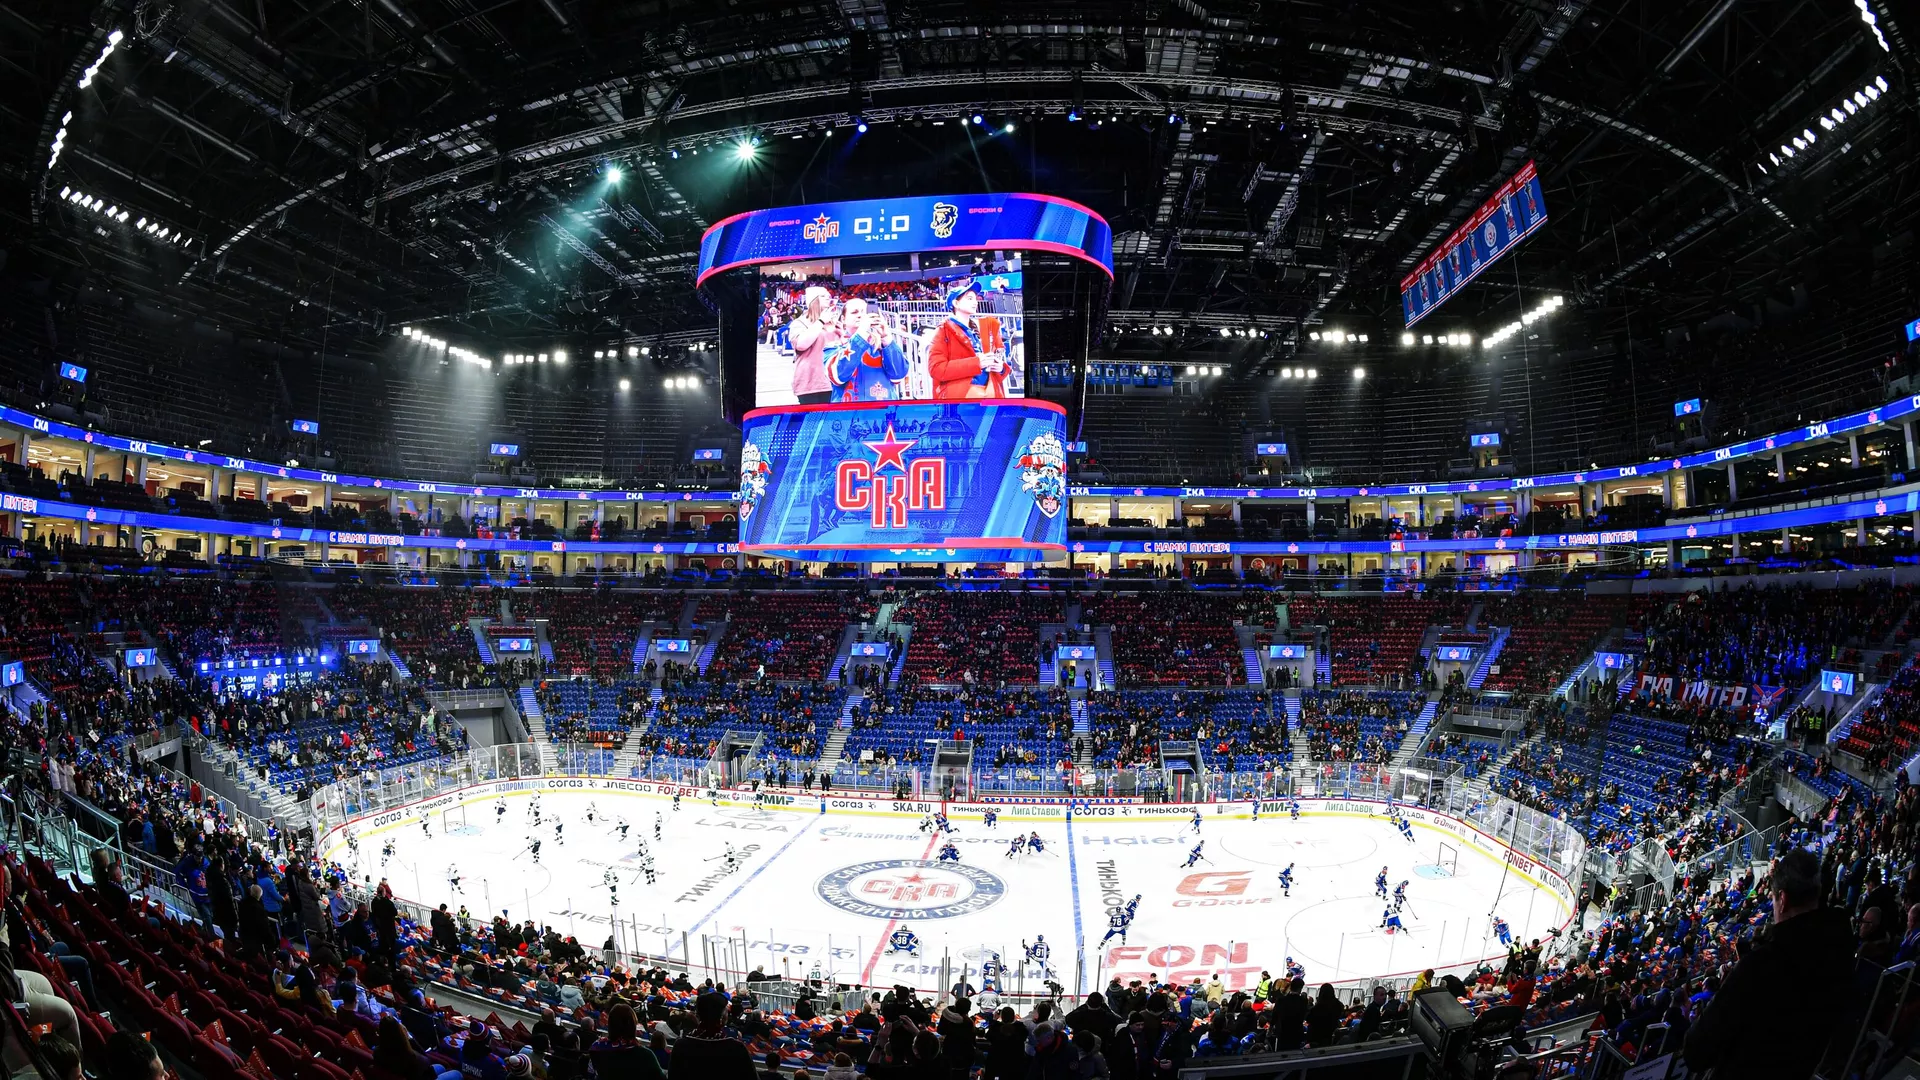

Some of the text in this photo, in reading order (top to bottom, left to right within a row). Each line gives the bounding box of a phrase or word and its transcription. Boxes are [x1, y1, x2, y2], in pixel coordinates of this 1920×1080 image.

[804, 220, 840, 244] СКА
[34, 418, 48, 432] СКА
[1810, 424, 1828, 438] СКА
[130, 440, 147, 453] СКА
[1715, 450, 1731, 460] СКА
[228, 458, 245, 470] СКА
[1620, 466, 1636, 476] СКА
[321, 472, 337, 483] СКА
[1516, 478, 1534, 488] СКА
[418, 483, 436, 492] СКА
[1070, 487, 1090, 495] СКА
[1186, 488, 1205, 496] СКА
[1298, 488, 1317, 497] СКА
[1409, 486, 1428, 494] СКА
[522, 490, 538, 498] СКА
[626, 492, 644, 500] СКА
[836, 457, 946, 530] СКА
[4, 494, 38, 513] ПИТЕР!
[330, 532, 404, 546] С НАМИ ПИТЕР!
[1559, 530, 1638, 546] С НАМИ ПИТЕР!
[717, 544, 724, 552] С
[1144, 542, 1230, 553] С НАМИ ПИТЕР!
[1641, 675, 1748, 706] СКА ПИТЕР
[764, 794, 795, 806] МИР
[892, 802, 932, 812] SKA.RU
[1406, 811, 1425, 820] LADA
[694, 818, 788, 832] LADA
[1082, 835, 1188, 846] Haier
[1502, 850, 1534, 875] FONBET
[860, 879, 960, 902] СКА
[822, 884, 997, 919] ХОККЕЙНЫЙ ГОРОД
[1112, 918, 1122, 926] 78
[896, 936, 908, 945] 98
[1100, 942, 1248, 968] FON
[810, 971, 821, 980] 20
